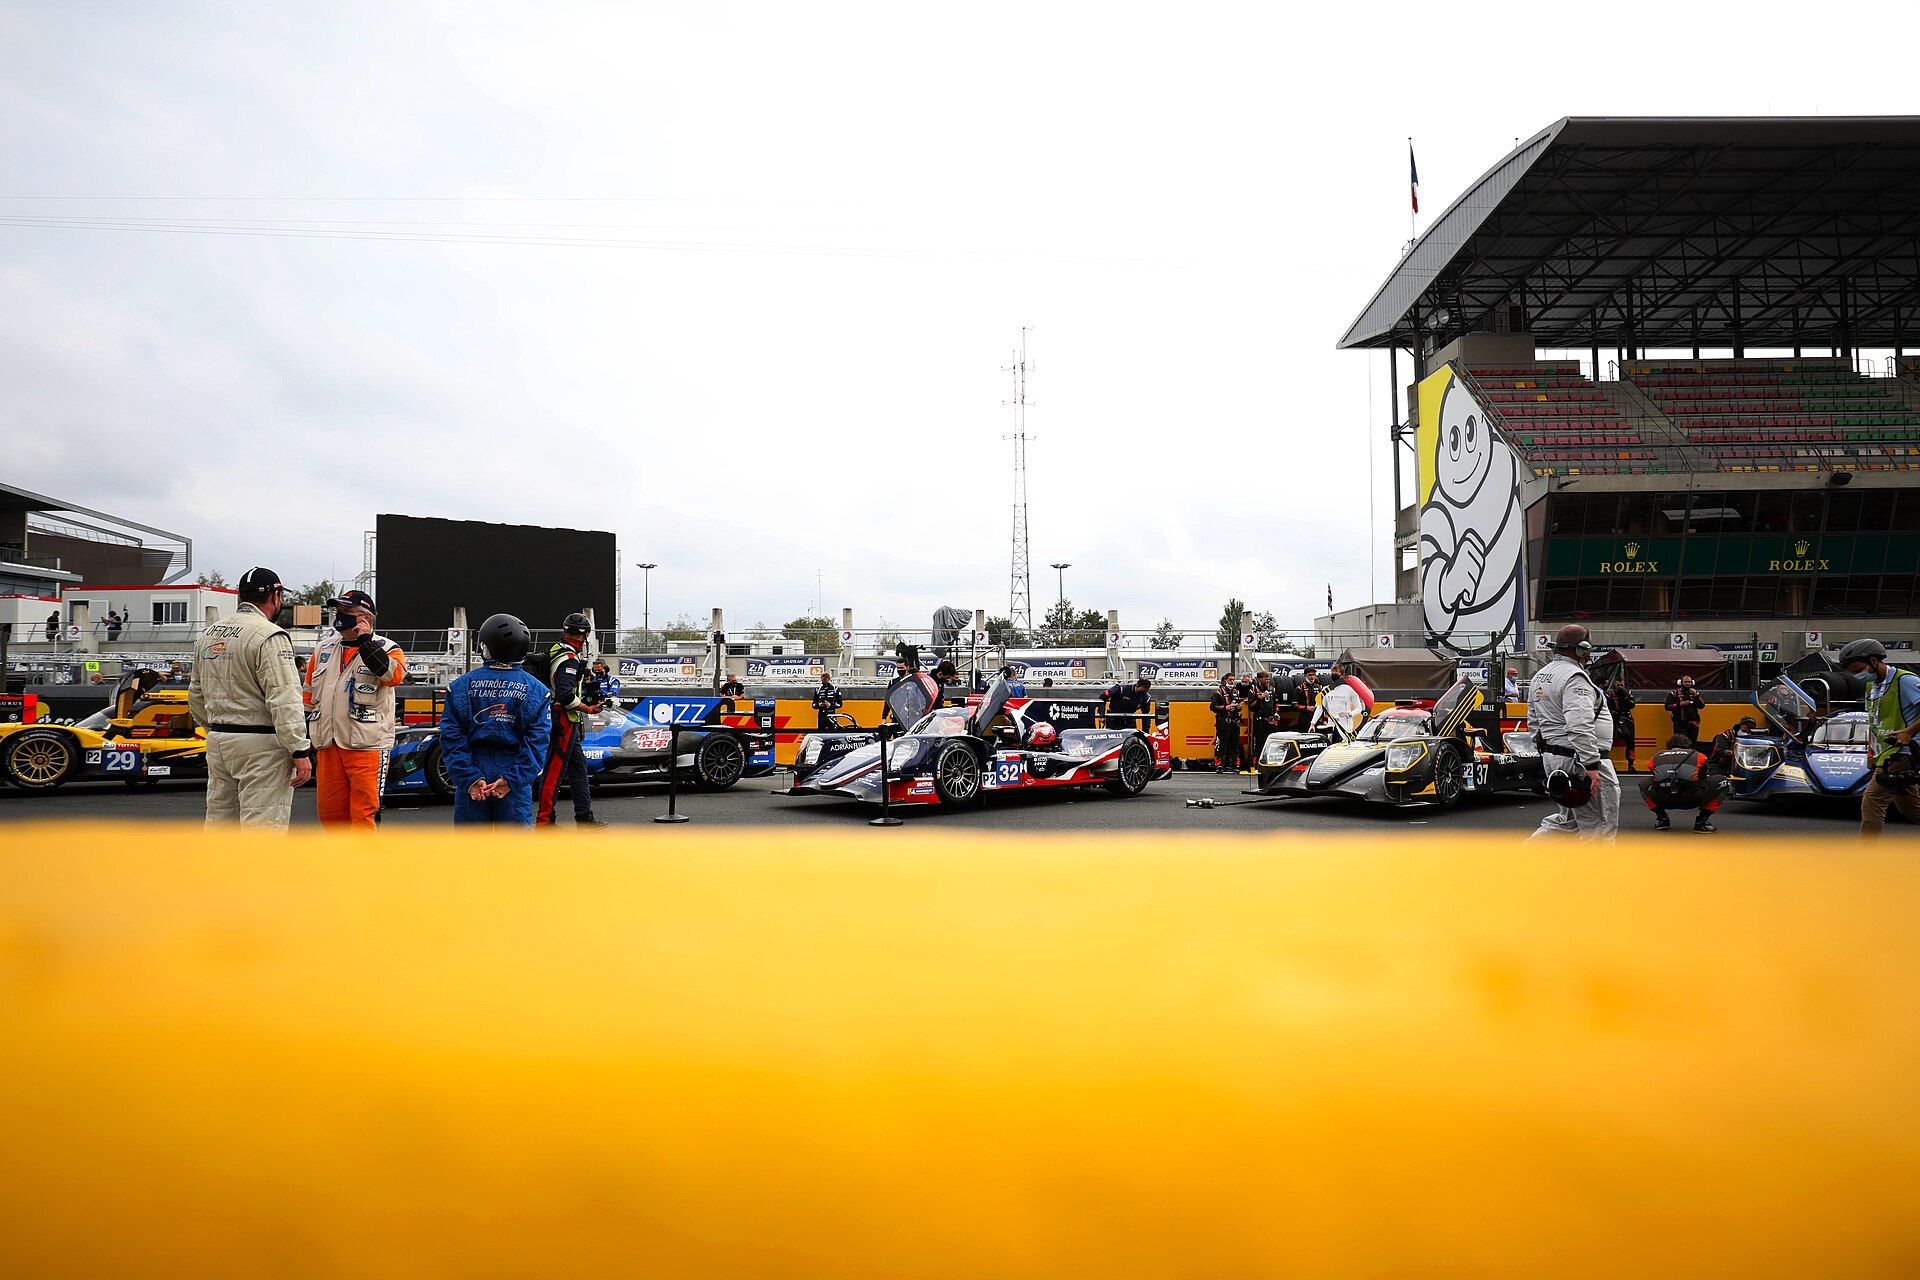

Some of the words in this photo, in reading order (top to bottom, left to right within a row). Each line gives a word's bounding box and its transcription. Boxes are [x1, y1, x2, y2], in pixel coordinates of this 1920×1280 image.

[1600, 561, 1658, 573] ROLEX
[1768, 559, 1830, 571] ROLEX
[206, 625, 244, 638] OFFICIAL
[620, 662, 636, 671] 24h
[748, 664, 764, 672] 24h
[879, 664, 894, 672] 24h
[1140, 666, 1156, 676] 24h
[470, 678, 508, 688] CONTRÔLE
[508, 682, 528, 692] PISTE
[478, 690, 497, 698] LANE
[649, 700, 706, 726] jazz
[1060, 705, 1073, 713] Global
[1074, 705, 1088, 713] Medical
[87, 752, 100, 762] P2
[106, 751, 136, 770] 29
[999, 764, 1018, 782] 32
[1462, 766, 1472, 775] P2
[1476, 764, 1488, 784] 37
[983, 773, 996, 786] P2
